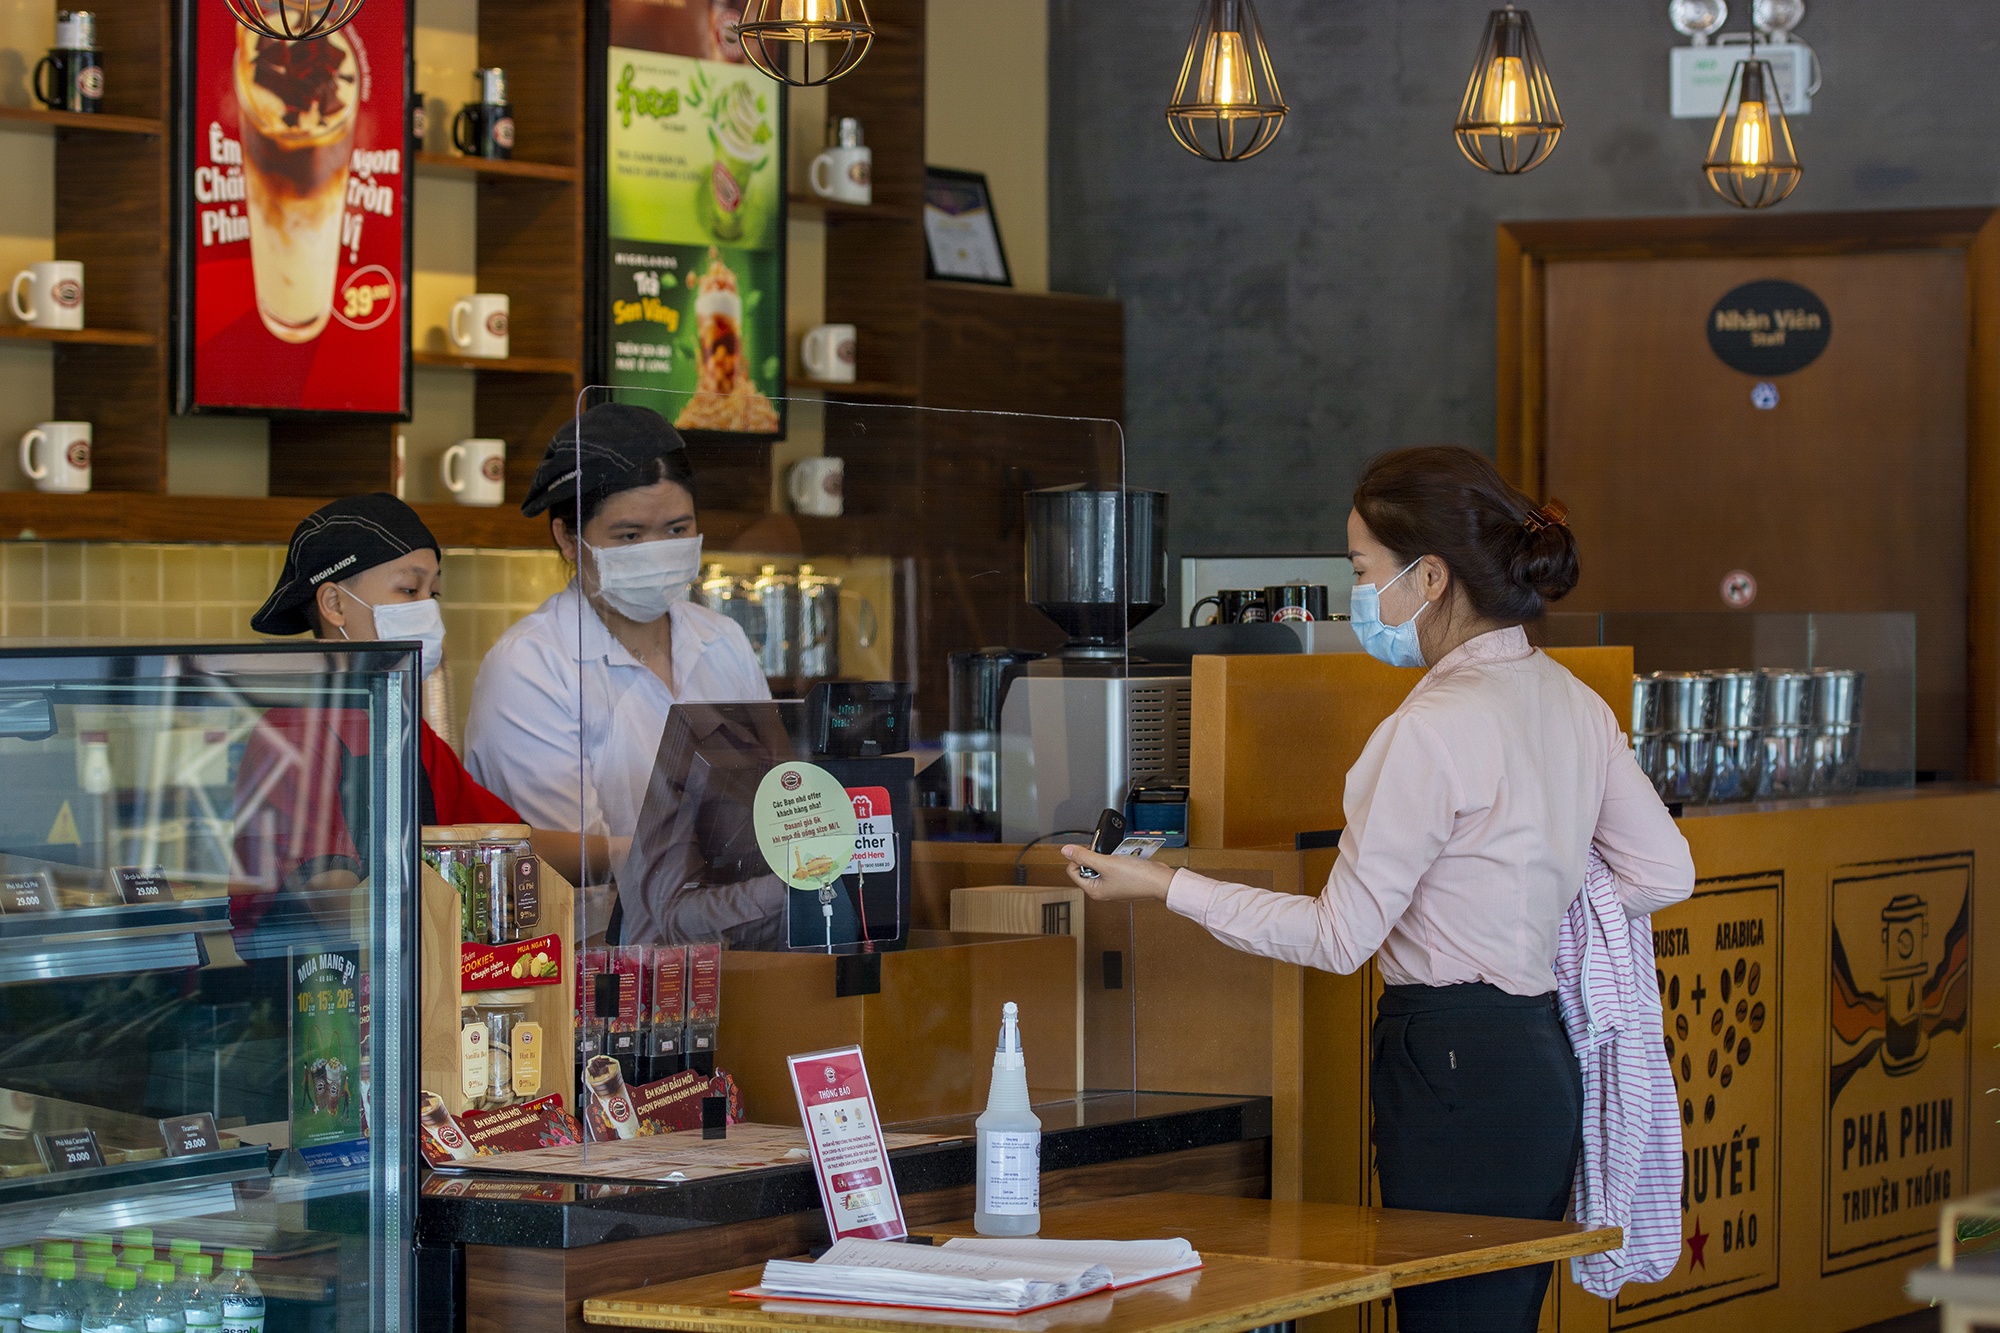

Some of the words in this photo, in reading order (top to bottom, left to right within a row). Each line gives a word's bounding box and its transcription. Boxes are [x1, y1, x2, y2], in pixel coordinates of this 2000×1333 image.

[615, 253, 678, 269] HIGHLANDS
[309, 554, 357, 585] HIGHLANDS
[776, 808, 793, 818] khách
[794, 805, 808, 814] hàng
[808, 801, 822, 811] nha!
[783, 798, 795, 807] Bạn
[807, 792, 821, 801] offer
[772, 835, 781, 844] khi
[816, 825, 828, 833] size
[828, 822, 840, 831] M/L
[784, 820, 802, 831] Dasani
[813, 816, 822, 824] 6k
[16, 896, 40, 906] 29.000
[136, 887, 159, 896] 29.000
[1716, 918, 1764, 951] ARABICA
[517, 945, 530, 953] MUA
[531, 940, 547, 950] NGAY
[298, 957, 318, 984] MUA
[319, 954, 344, 972] MANG
[461, 952, 494, 975] COOKIES
[298, 992, 314, 1012] 10%
[318, 990, 333, 1011] 15%
[337, 988, 354, 1008] 20%
[645, 1089, 655, 1100] ÊM
[654, 1082, 668, 1095] KHỞI
[668, 1077, 681, 1091] ĐẦU
[681, 1073, 694, 1086] MỚI
[818, 1087, 839, 1100] THÔNG
[839, 1085, 851, 1096] BÁO
[637, 1103, 654, 1116] CHỌN
[654, 1095, 674, 1109] PHINDI
[673, 1090, 690, 1103] HẠNH
[690, 1081, 709, 1095] NHÂN!
[470, 1130, 487, 1143] CHỌN
[486, 1122, 507, 1138] PHINDI
[505, 1118, 522, 1132] HẠNH
[521, 1113, 540, 1127] NHÂN!
[473, 1120, 486, 1129] ÊM
[485, 1113, 498, 1125] KHỞI
[498, 1109, 510, 1122] ĐẦU
[510, 1107, 522, 1118] MỚI
[184, 1138, 206, 1150] 29.000
[1843, 1110, 1889, 1172] PHA
[1900, 1098, 1953, 1159] PHIN
[67, 1152, 90, 1162] 29.000
[1843, 1176, 1899, 1225] TRUYỀN
[1906, 1164, 1951, 1209] THỐNG
[1723, 1210, 1757, 1254] ĐÁO
